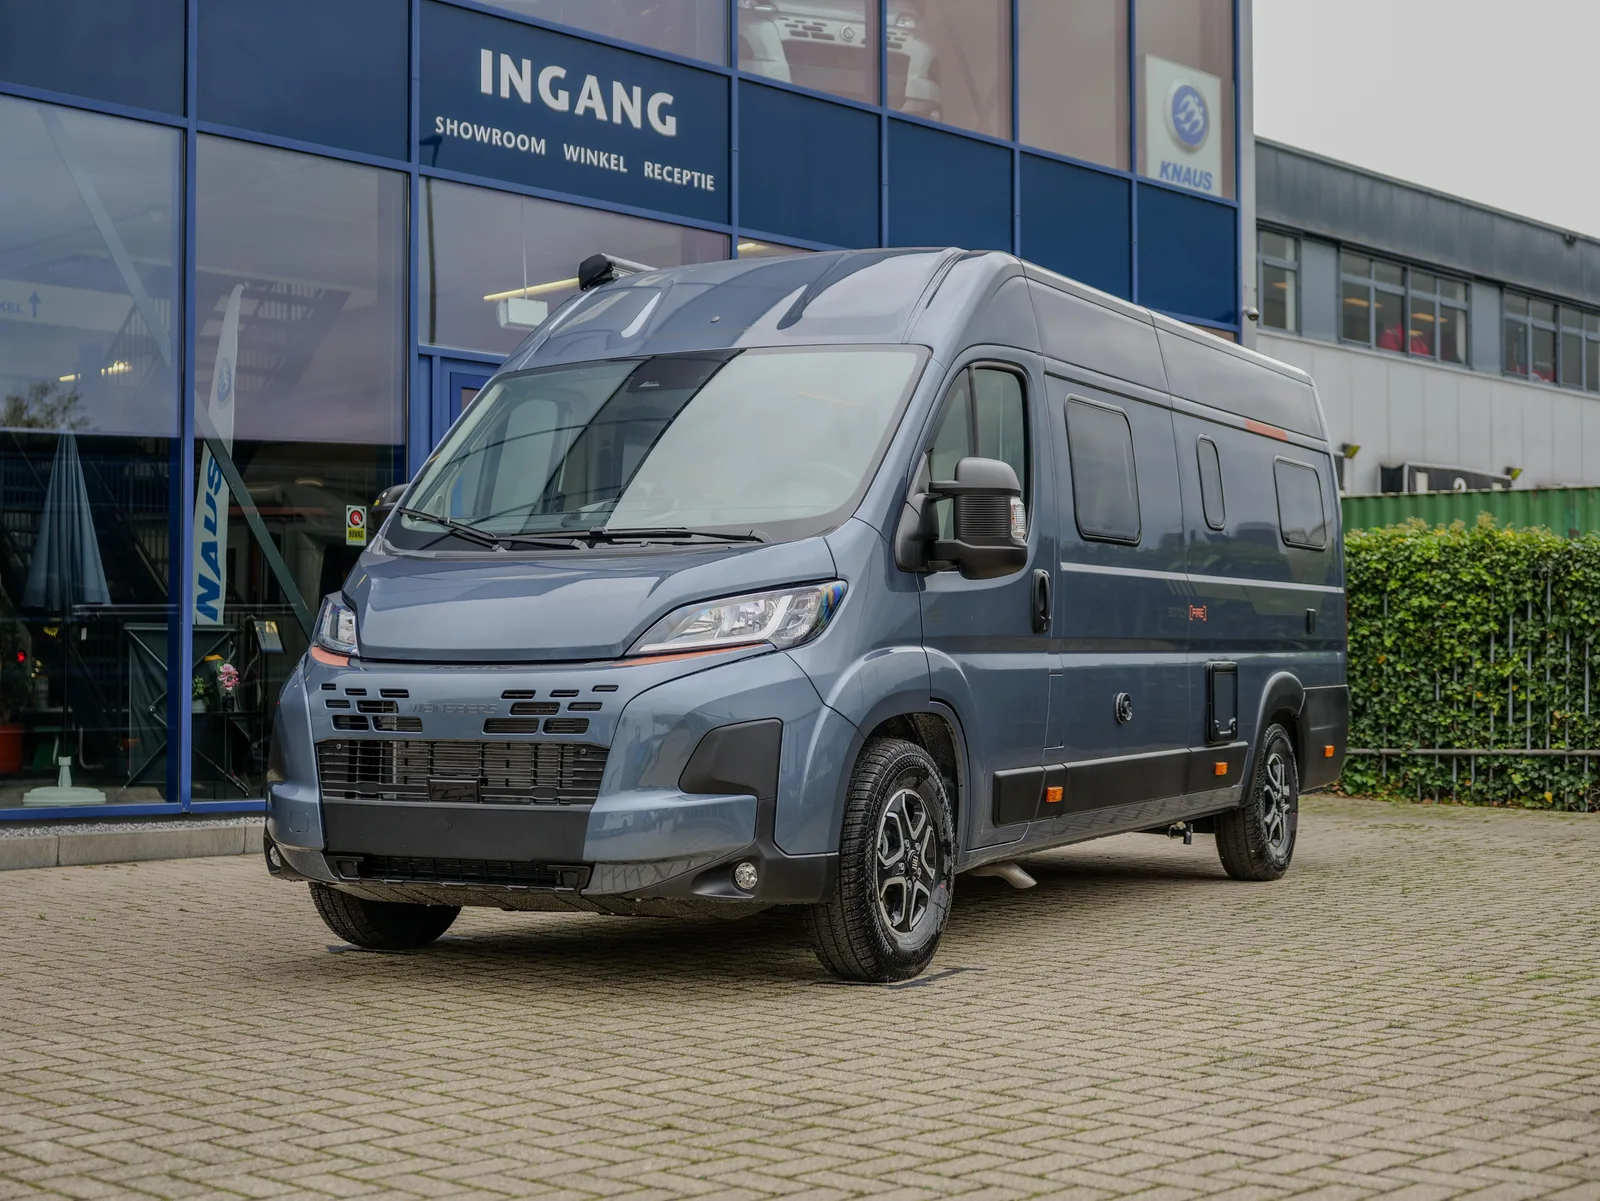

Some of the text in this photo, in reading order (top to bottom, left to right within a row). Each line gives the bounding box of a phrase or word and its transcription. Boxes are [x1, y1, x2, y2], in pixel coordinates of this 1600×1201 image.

[480, 48, 677, 137] INGANG
[435, 115, 715, 191] SHOWROOM WINKEL RECEPTIE
[1160, 160, 1213, 190] KNAUS
[196, 454, 222, 622] NAUS
[410, 703, 499, 715] WEINSBERG
